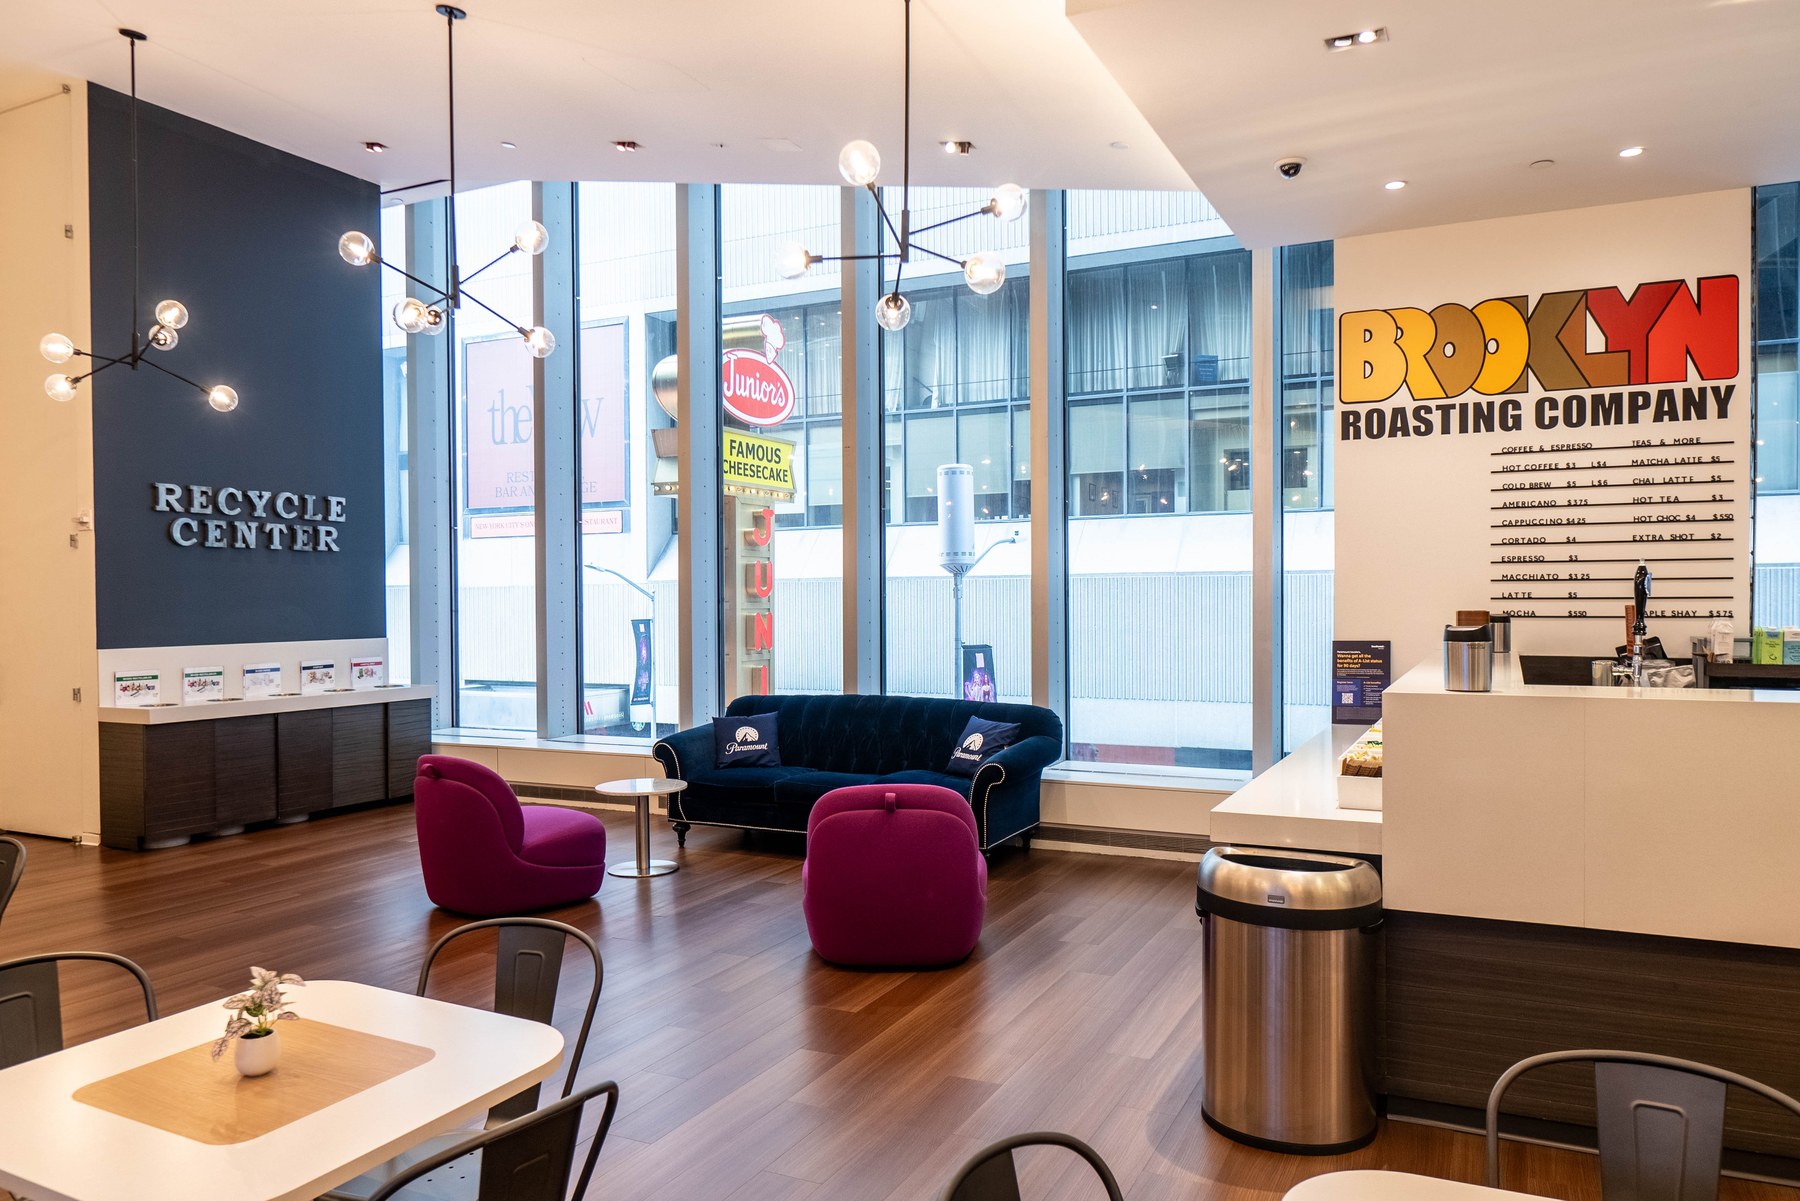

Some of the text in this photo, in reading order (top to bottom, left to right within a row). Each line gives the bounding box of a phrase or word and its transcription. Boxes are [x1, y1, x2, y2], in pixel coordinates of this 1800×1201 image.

[1339, 274, 1740, 404] BROOKLYN
[724, 352, 786, 407] Junior's
[487, 388, 533, 446] the
[1341, 384, 1736, 441] ROASTING COMPANY
[1632, 437, 1701, 447] TEAS & MORE
[729, 439, 782, 464] FAMOUS
[1501, 445, 1534, 454] COFFEE
[1550, 442, 1593, 451] ESPRESSO
[1631, 455, 1721, 466] MATCHA LATTE $5
[723, 459, 788, 483] CHEESECAKE
[1502, 464, 1521, 472] HOT
[1524, 462, 1560, 471] COFFEE
[1565, 461, 1576, 469] $3
[1502, 482, 1526, 490] COLD
[1529, 481, 1552, 490] BREW
[1566, 480, 1577, 488] $5
[1632, 474, 1722, 485] CHAI LATTE $5
[495, 485, 535, 498] BAR AN
[153, 482, 347, 523] RECYCLE
[1502, 498, 1588, 508] AMERICANO $375
[1632, 494, 1723, 504] HOT TEA $3
[1501, 517, 1563, 526] CAPPUCCINO
[1633, 515, 1653, 523] HOT
[1656, 514, 1681, 522] CHOC
[1712, 513, 1734, 521] $550
[169, 517, 340, 552] CENTER
[1632, 532, 1722, 542] EXTRA SHOT $2
[1501, 536, 1547, 545] CORTADO
[1568, 554, 1579, 562] $3
[1501, 591, 1578, 599] LATTE $5
[1644, 609, 1666, 617] APLE
[1671, 609, 1698, 617] SHAY
[725, 741, 769, 755] Paramount
[950, 746, 983, 762] Paramount
